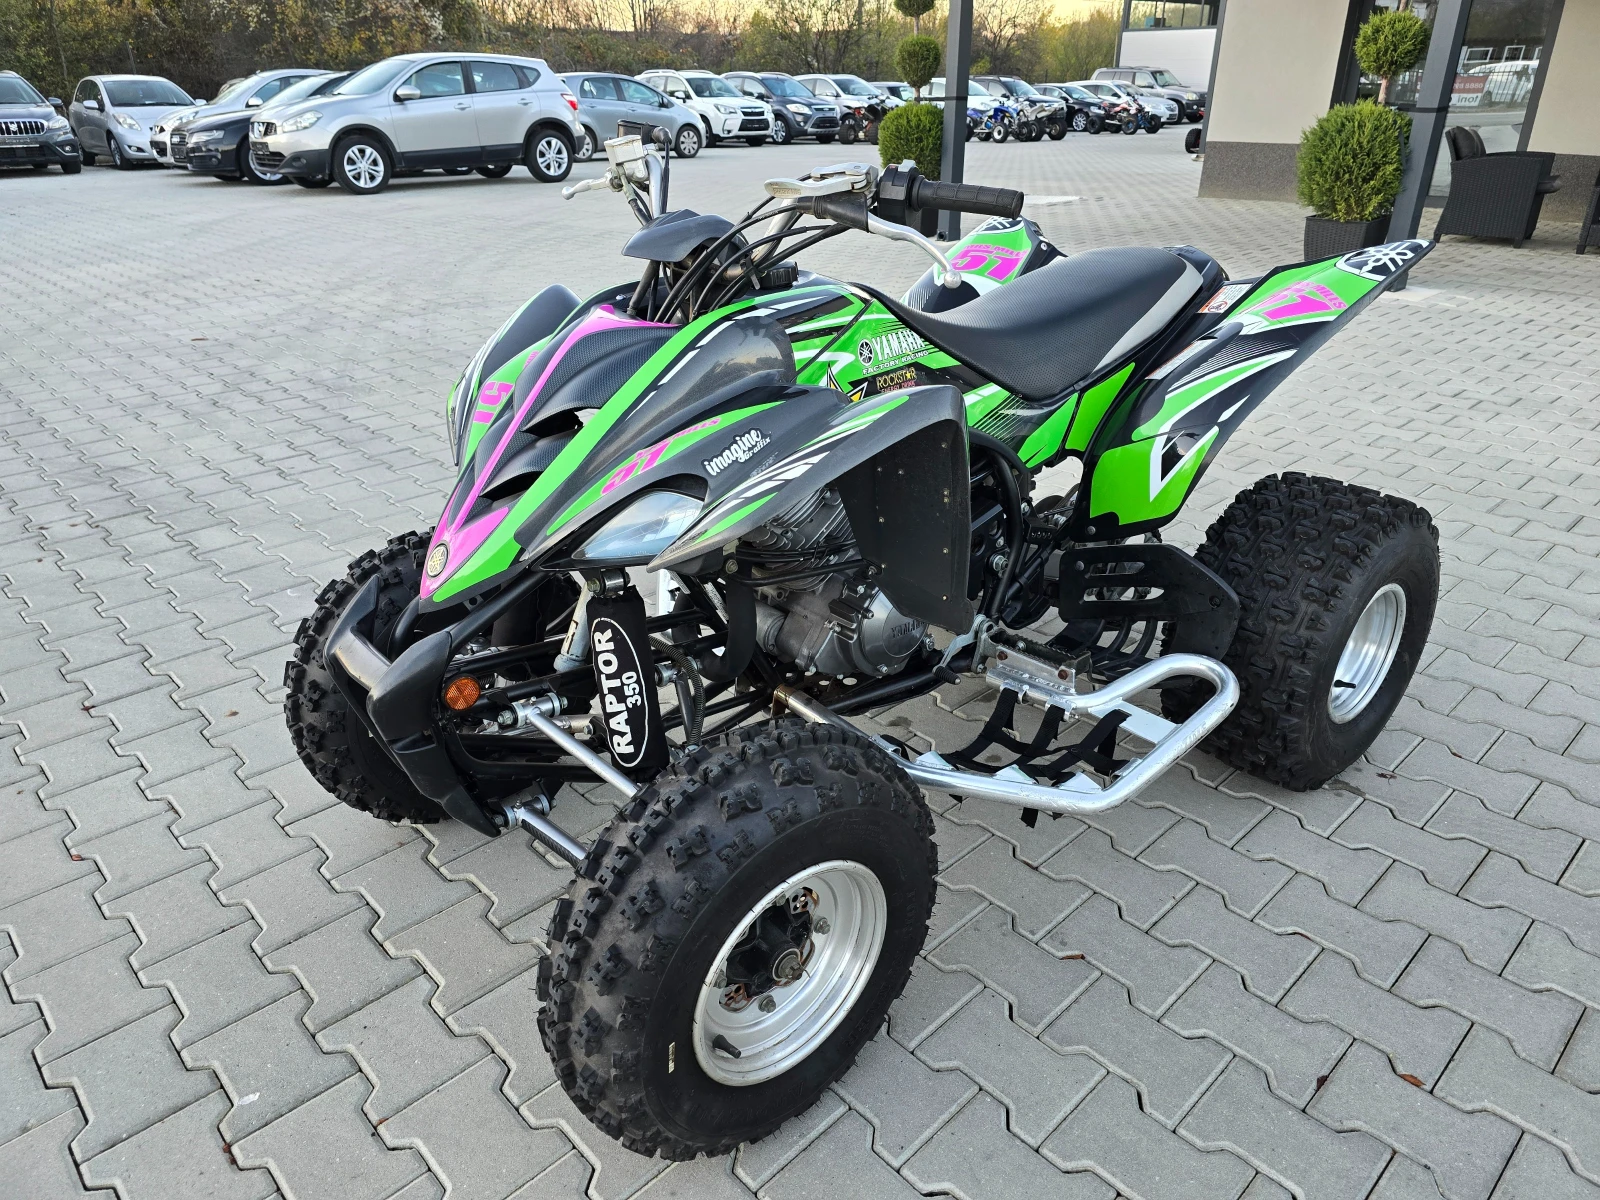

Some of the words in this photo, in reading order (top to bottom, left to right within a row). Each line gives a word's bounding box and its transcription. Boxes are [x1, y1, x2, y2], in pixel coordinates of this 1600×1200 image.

[862, 360, 900, 375] FACTORY
[901, 350, 929, 363] RACING
[871, 328, 926, 361] YAMAHA
[703, 429, 762, 476] imagine
[743, 435, 772, 461] Graffix
[594, 628, 635, 754] RAPTOR
[621, 671, 643, 710] 350
